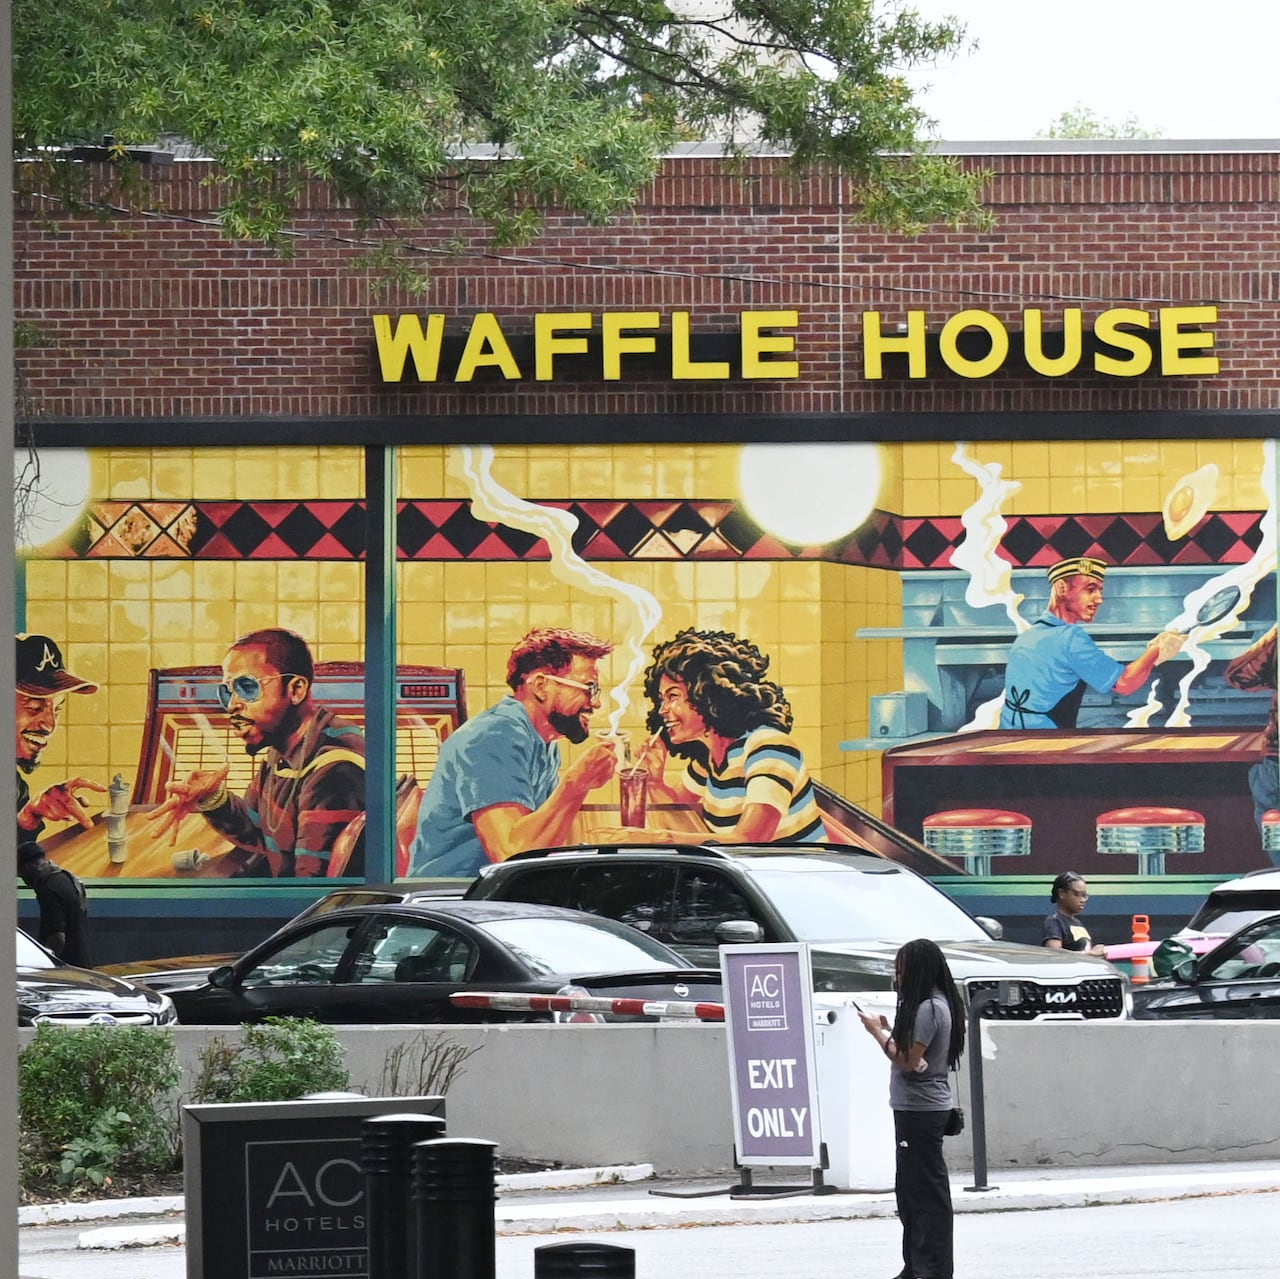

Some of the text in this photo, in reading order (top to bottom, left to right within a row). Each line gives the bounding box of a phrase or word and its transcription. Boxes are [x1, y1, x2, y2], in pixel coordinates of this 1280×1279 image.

[374, 306, 1220, 383] WAFFLE HOUSE
[34, 643, 59, 671] A
[750, 974, 779, 998] AC
[748, 1058, 796, 1089] EXIT
[748, 1107, 807, 1138] ONLY
[266, 1158, 365, 1209] AC
[265, 1215, 366, 1232] HOTELS
[268, 1254, 367, 1272] MARRIOTT
